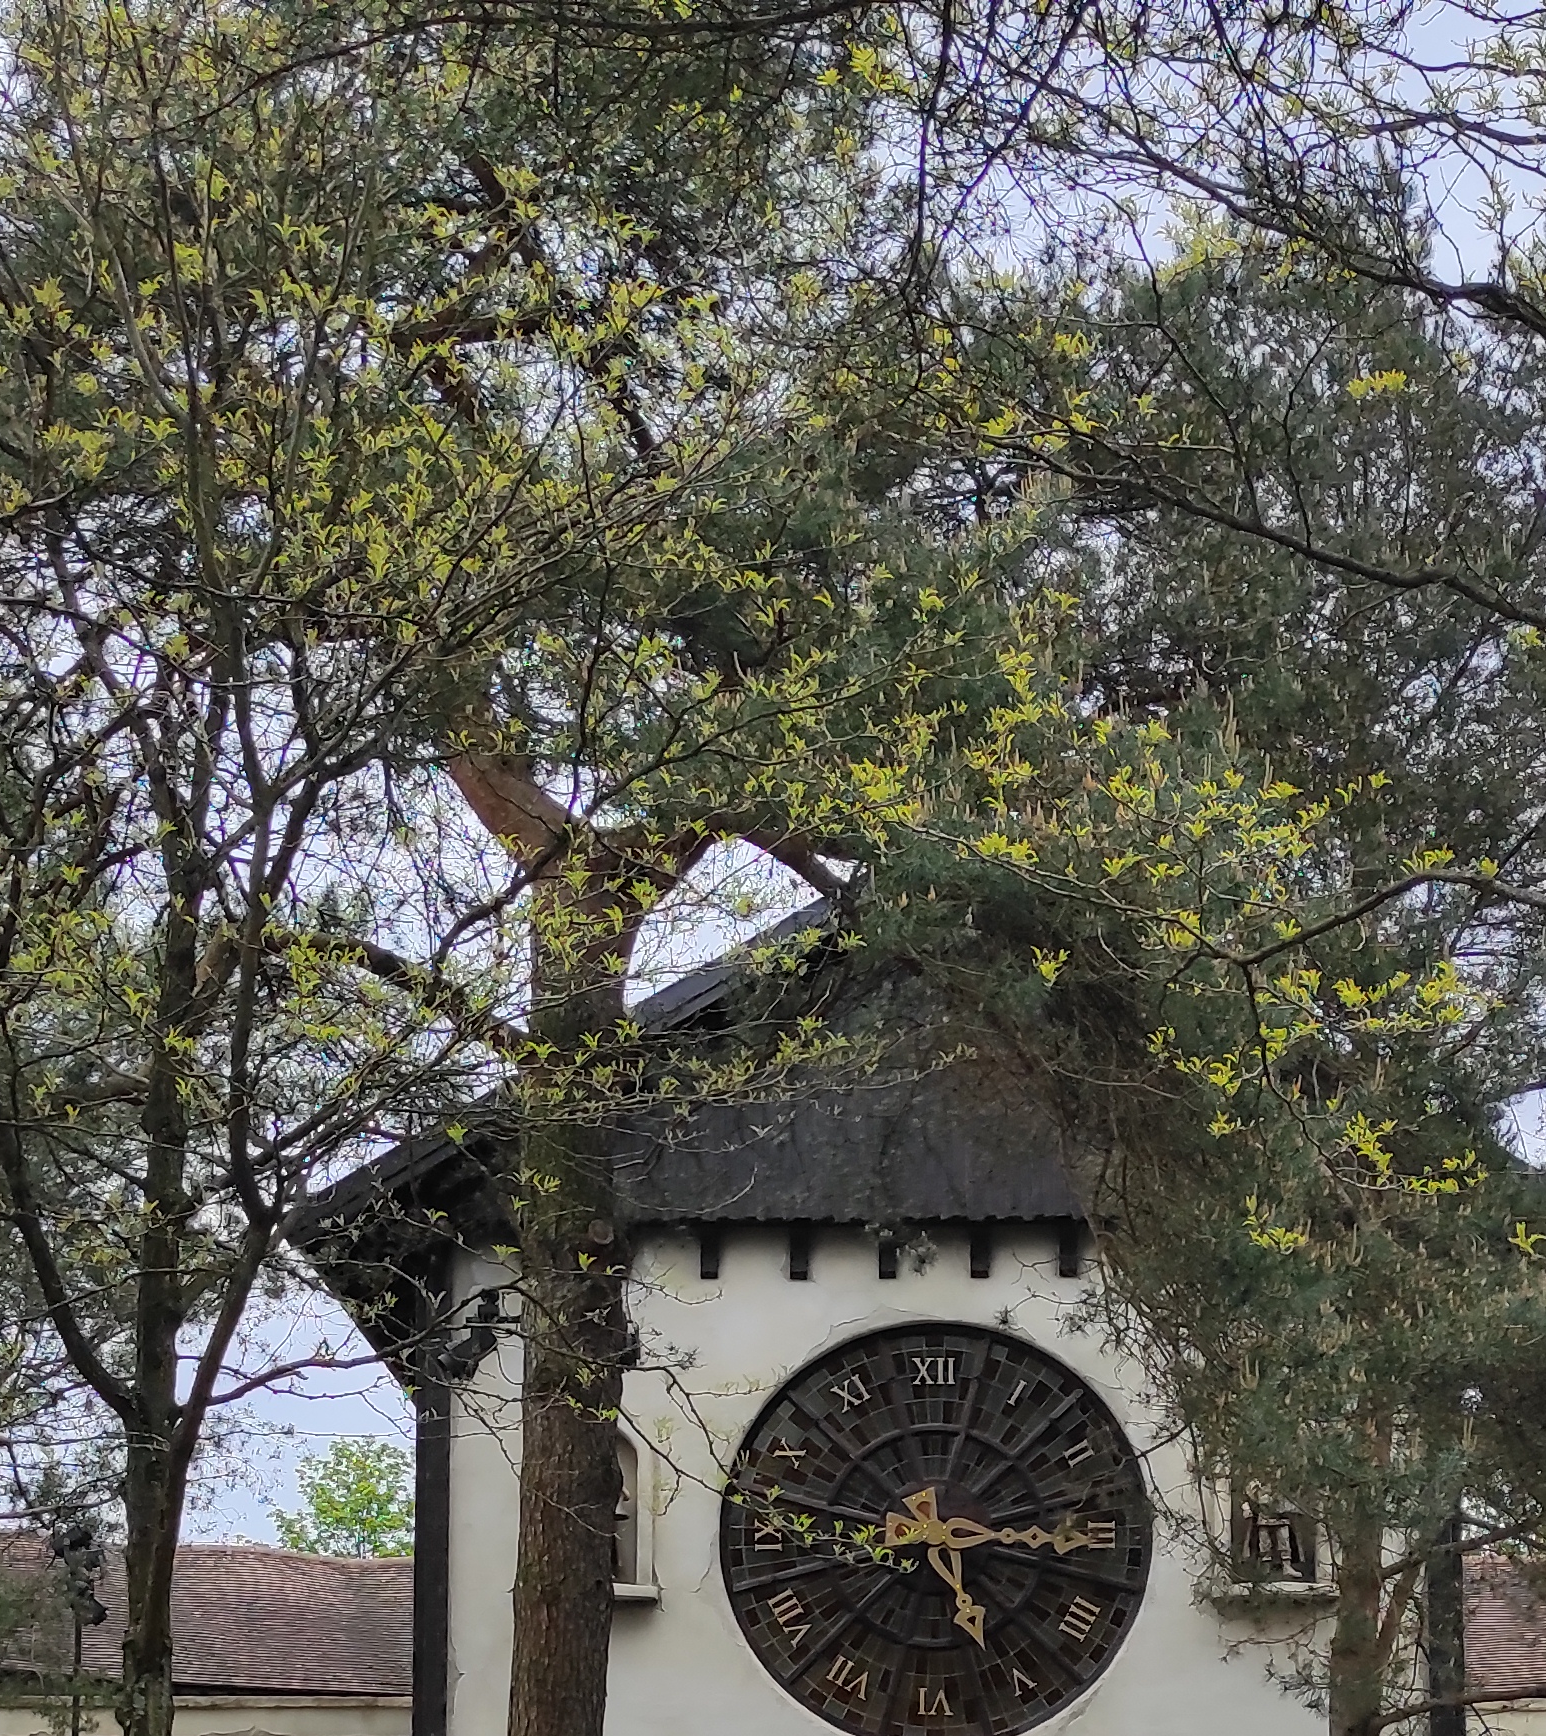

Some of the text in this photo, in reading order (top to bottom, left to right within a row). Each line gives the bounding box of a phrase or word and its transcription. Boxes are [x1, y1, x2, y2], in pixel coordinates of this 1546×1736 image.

[911, 1357, 956, 1386] XII
[830, 1373, 872, 1414] XI
[1006, 1379, 1028, 1407] I
[772, 1436, 807, 1470] X
[1062, 1438, 1095, 1469] II
[753, 1517, 784, 1552] IX
[766, 1586, 814, 1649] VIII
[1057, 1594, 1103, 1643] IIII
[824, 1653, 870, 1701] VII
[1011, 1667, 1038, 1698] V
[916, 1686, 955, 1717] VI
